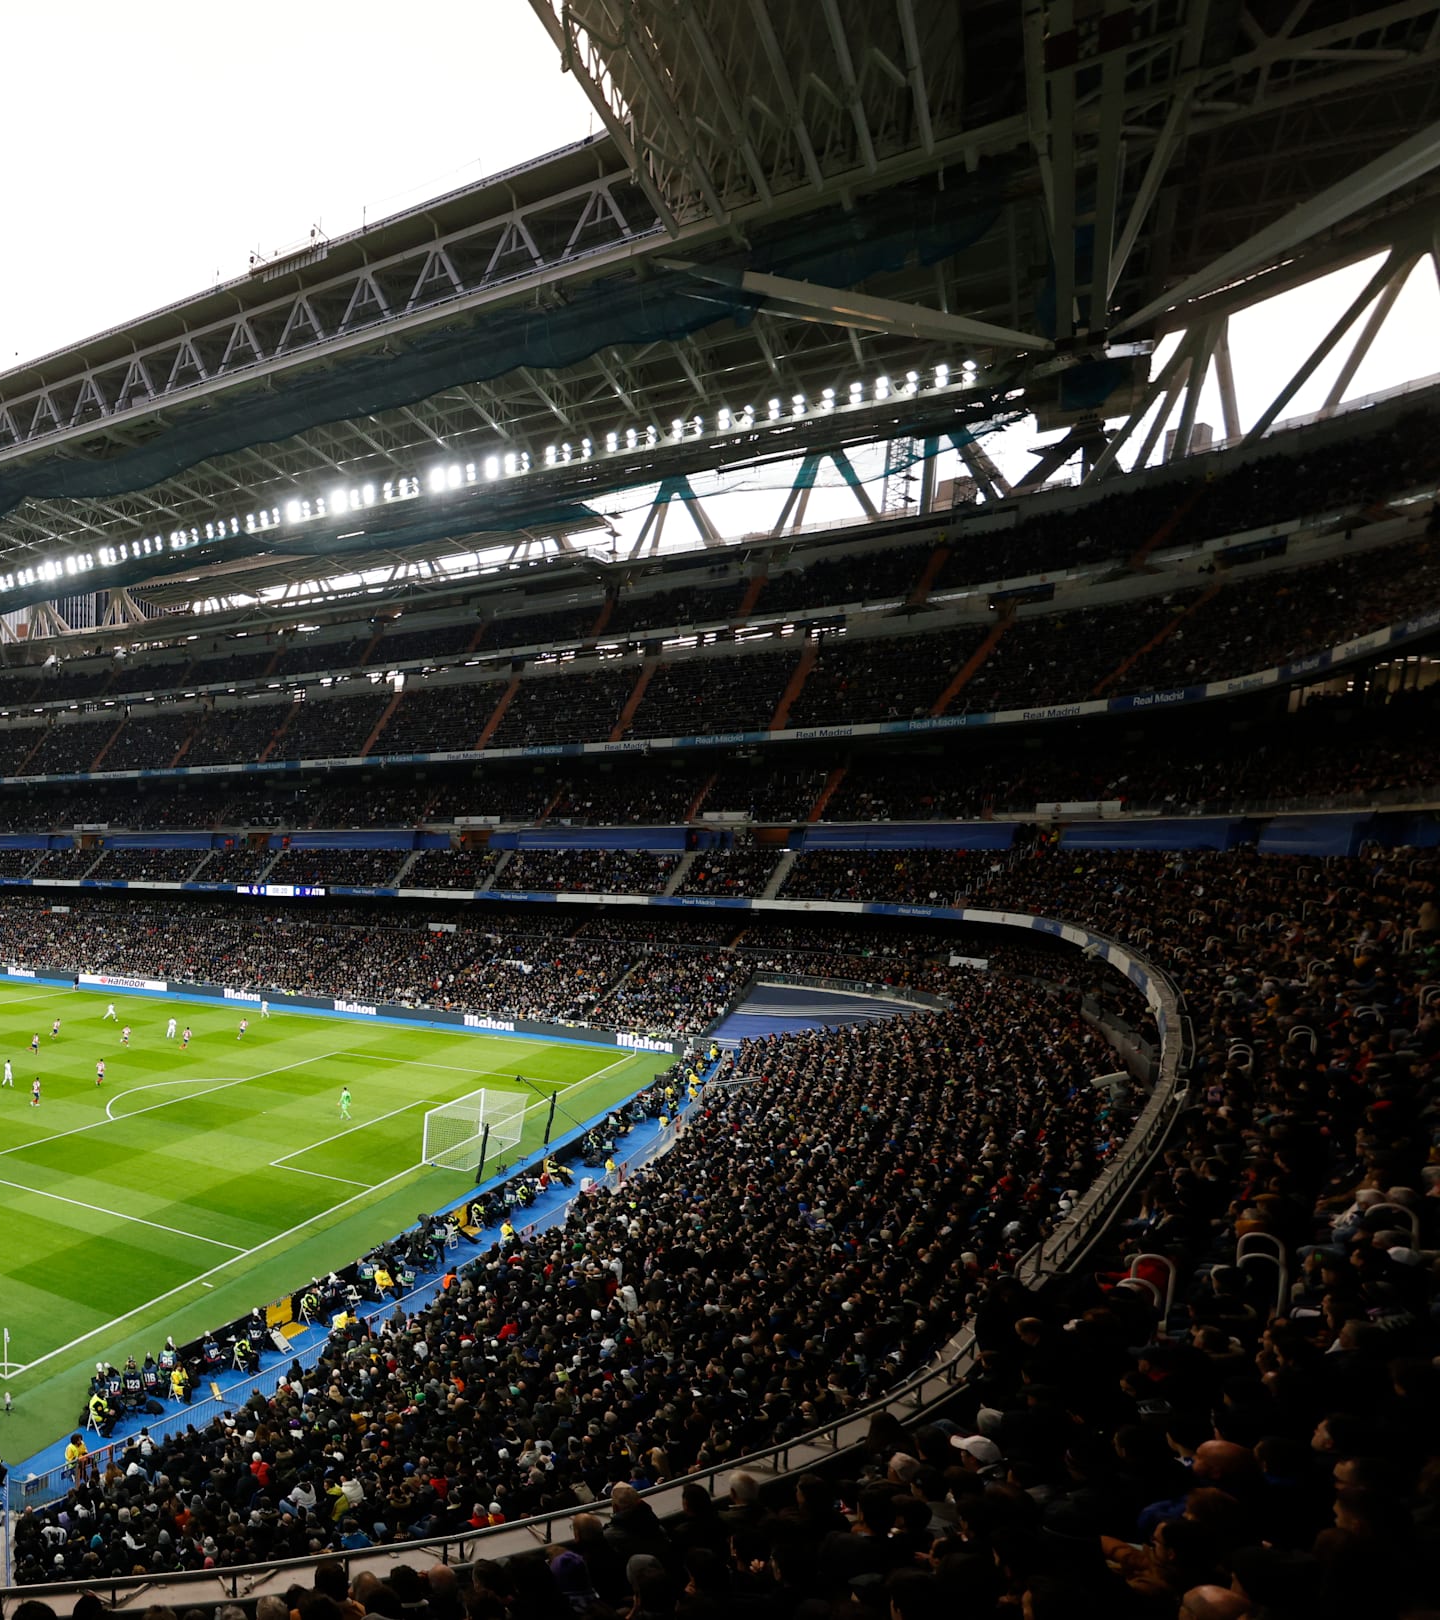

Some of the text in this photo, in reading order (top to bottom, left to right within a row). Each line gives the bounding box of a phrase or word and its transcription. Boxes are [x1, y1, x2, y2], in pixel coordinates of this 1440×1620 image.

[1133, 691, 1184, 706] Real Madrid
[1023, 706, 1080, 720] Real Madrid
[909, 717, 966, 730] Real Madrid
[695, 734, 744, 745] Real Madrid
[796, 728, 852, 739] Real Madrid
[523, 746, 563, 755] Real Madrid
[7, 967, 35, 978] Mahou
[224, 988, 261, 1002] Mahou
[334, 1000, 377, 1015] Mahou
[464, 1014, 515, 1031] Mahou
[616, 1033, 673, 1053] Mahou
[126, 1379, 141, 1389] 123
[144, 1373, 157, 1383] 116
